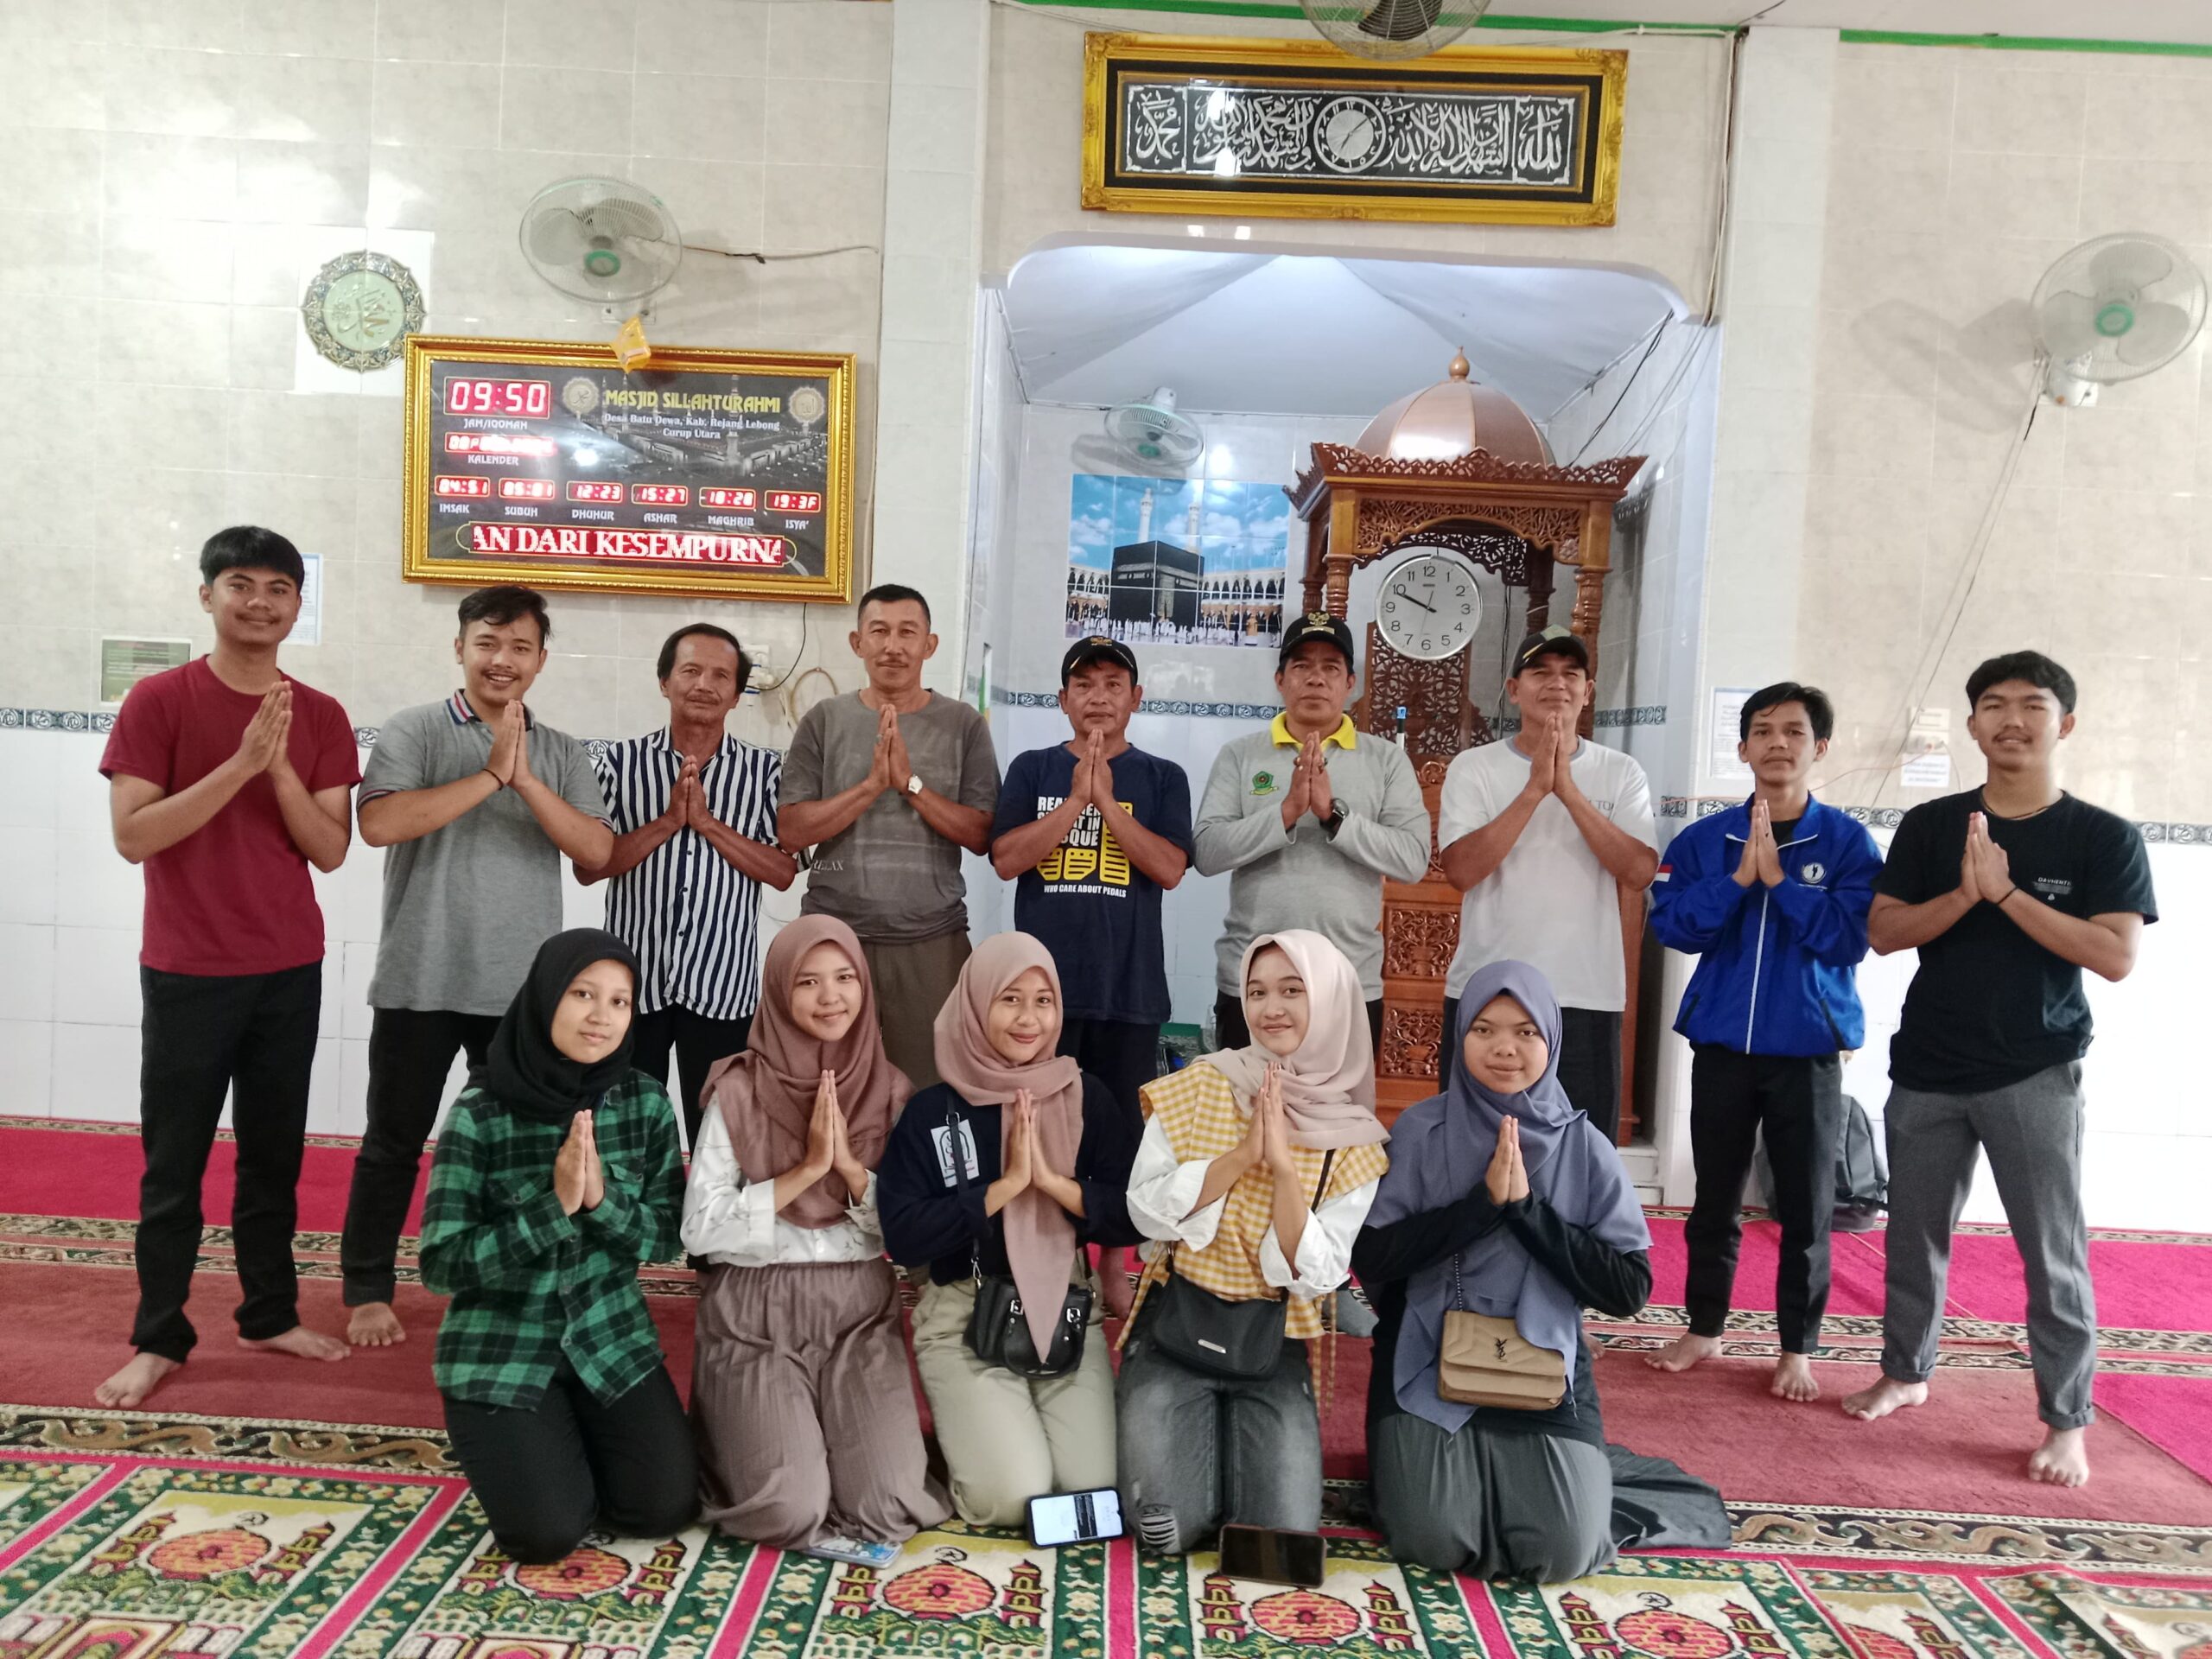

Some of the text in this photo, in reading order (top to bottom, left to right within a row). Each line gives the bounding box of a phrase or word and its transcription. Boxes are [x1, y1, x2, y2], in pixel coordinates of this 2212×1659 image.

[451, 382, 546, 412] 09:50
[606, 389, 780, 413] MASJID SILLAHTURAHMI
[605, 413, 627, 423] Desa
[630, 414, 652, 424] Batu
[655, 415, 683, 426] Dewa,
[710, 416, 743, 429] Rejang
[746, 420, 780, 431] Lebong
[663, 428, 721, 439] Curup Utara
[467, 454, 519, 466] KALENDER
[576, 485, 621, 500] 12:23
[641, 487, 685, 502] 15:27
[439, 504, 470, 514] IMSAK
[505, 506, 538, 518] SUBUH
[571, 509, 615, 521] DHUHUR
[643, 512, 678, 524] ASHAR
[708, 516, 754, 526] MAGHRIB
[515, 526, 590, 556] DARI
[1408, 571, 1414, 582] 11
[1424, 566, 1435, 577] 12
[1393, 584, 1407, 594] 10
[1455, 585, 1465, 596] 2
[1385, 602, 1395, 613] 9
[1461, 603, 1471, 614] 3
[1390, 620, 1401, 632] 8
[1454, 622, 1463, 632] 4
[1404, 634, 1414, 645] 7
[1421, 639, 1431, 651] 6
[1441, 635, 1451, 646] 5
[1037, 796, 1069, 813] REA
[1044, 884, 1127, 898] WHO CARE ABOUT PEDALS
